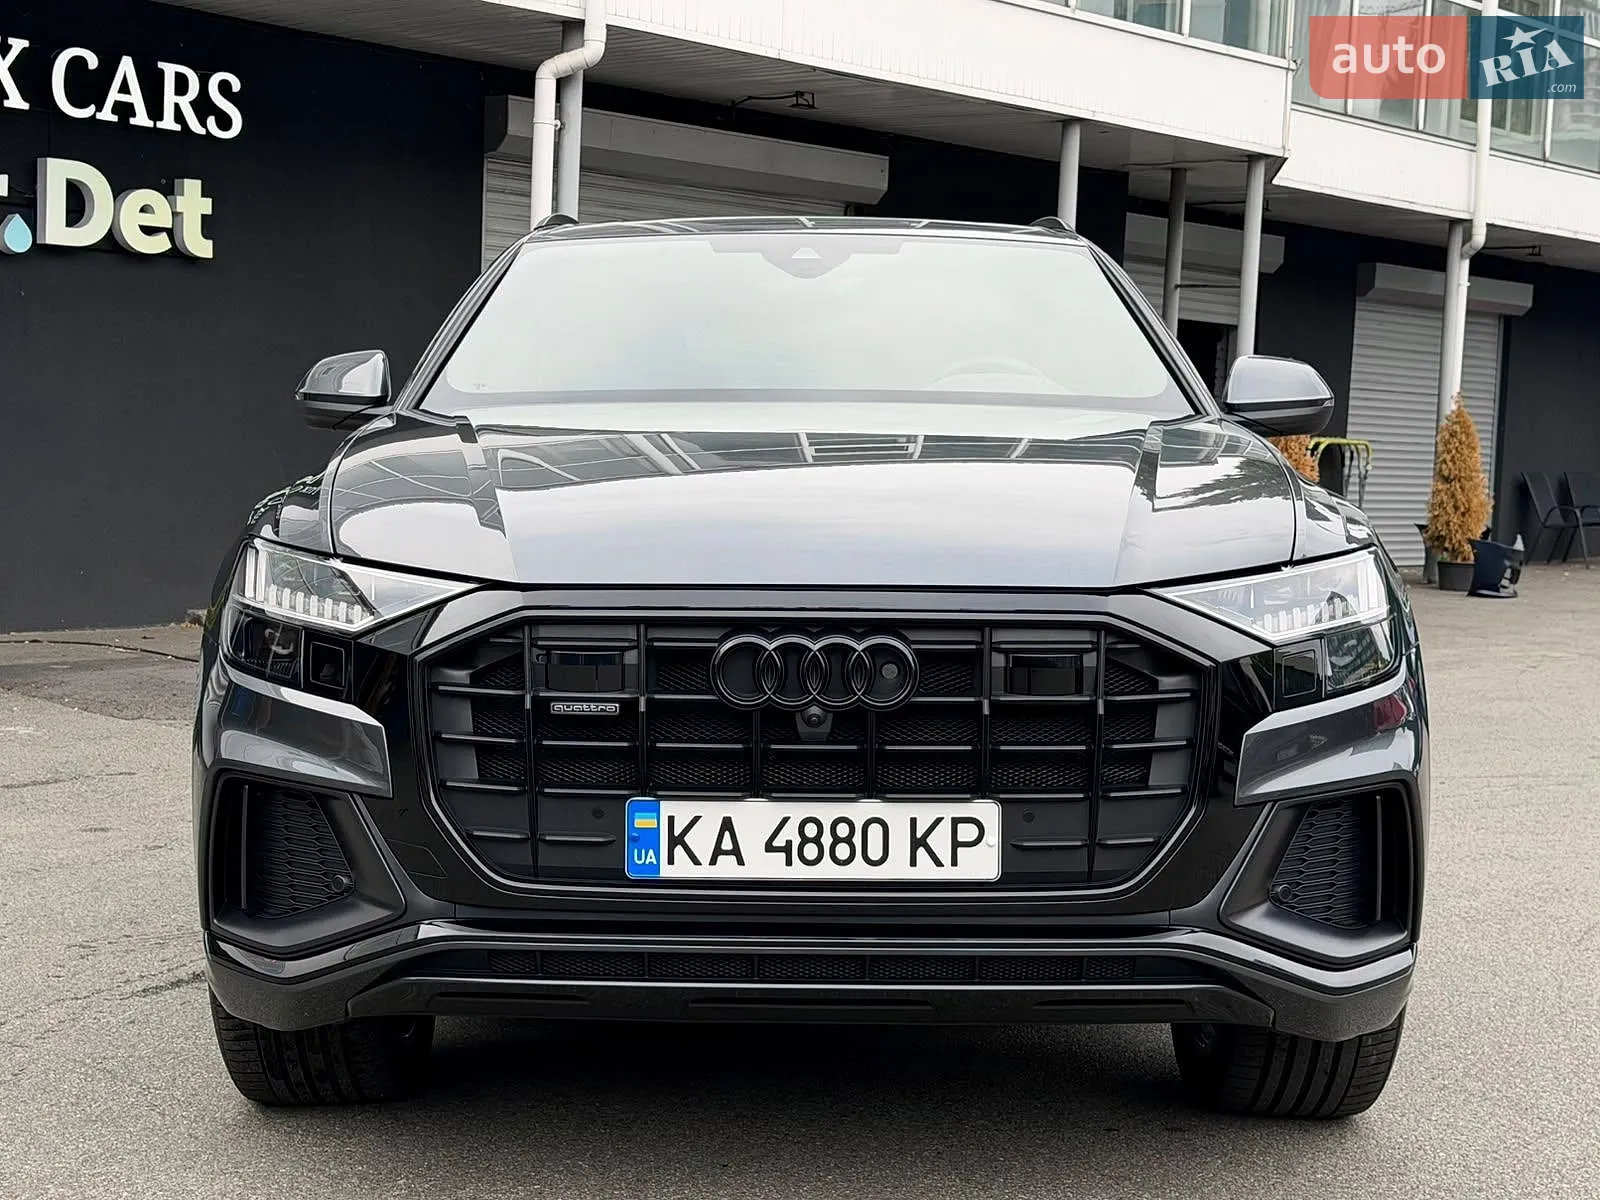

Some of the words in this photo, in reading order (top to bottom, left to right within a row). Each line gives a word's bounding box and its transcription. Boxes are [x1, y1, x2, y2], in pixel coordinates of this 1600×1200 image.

[51, 47, 243, 139] CARS
[552, 703, 618, 713] quattro
[634, 848, 657, 866] UA
[666, 815, 746, 867] KA
[764, 815, 890, 868] 4880
[909, 816, 986, 868] KP
